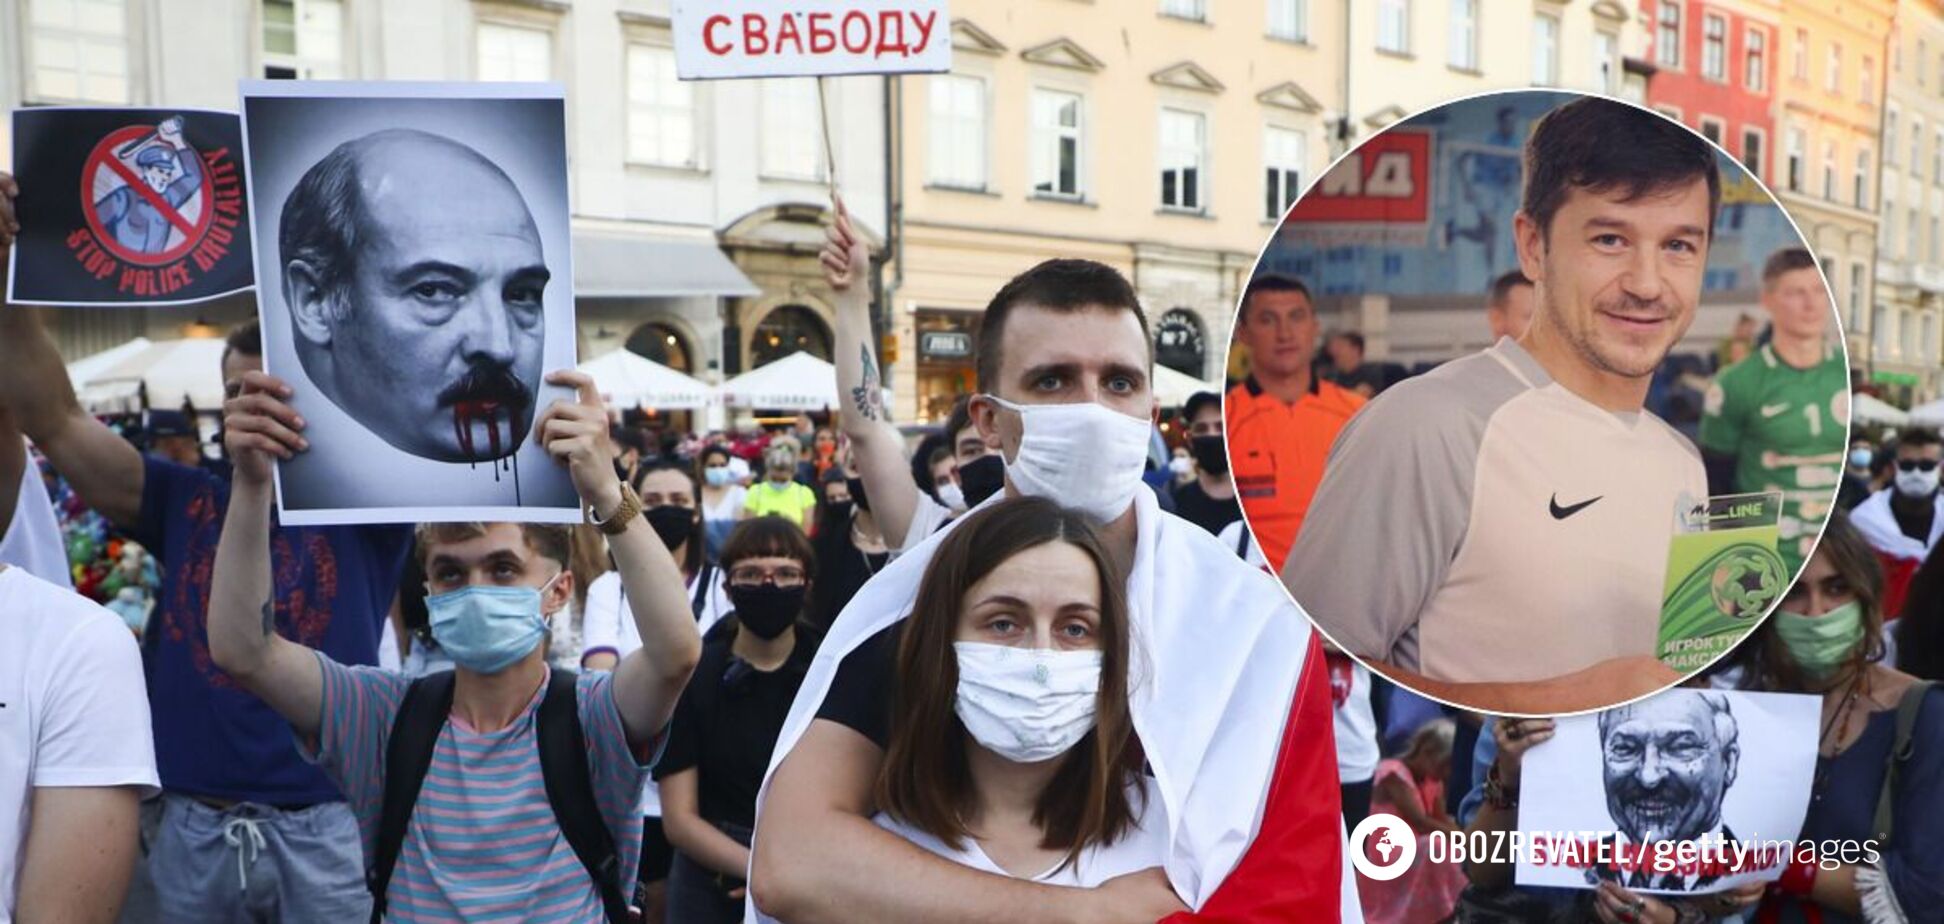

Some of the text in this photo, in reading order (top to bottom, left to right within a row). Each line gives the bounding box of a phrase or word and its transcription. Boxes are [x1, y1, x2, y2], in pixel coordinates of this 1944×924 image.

[702, 10, 937, 59] СВАБОДУ
[66, 147, 242, 295] STOP POLICE BRUTALITY
[1664, 637, 1713, 653] ИГРОК
